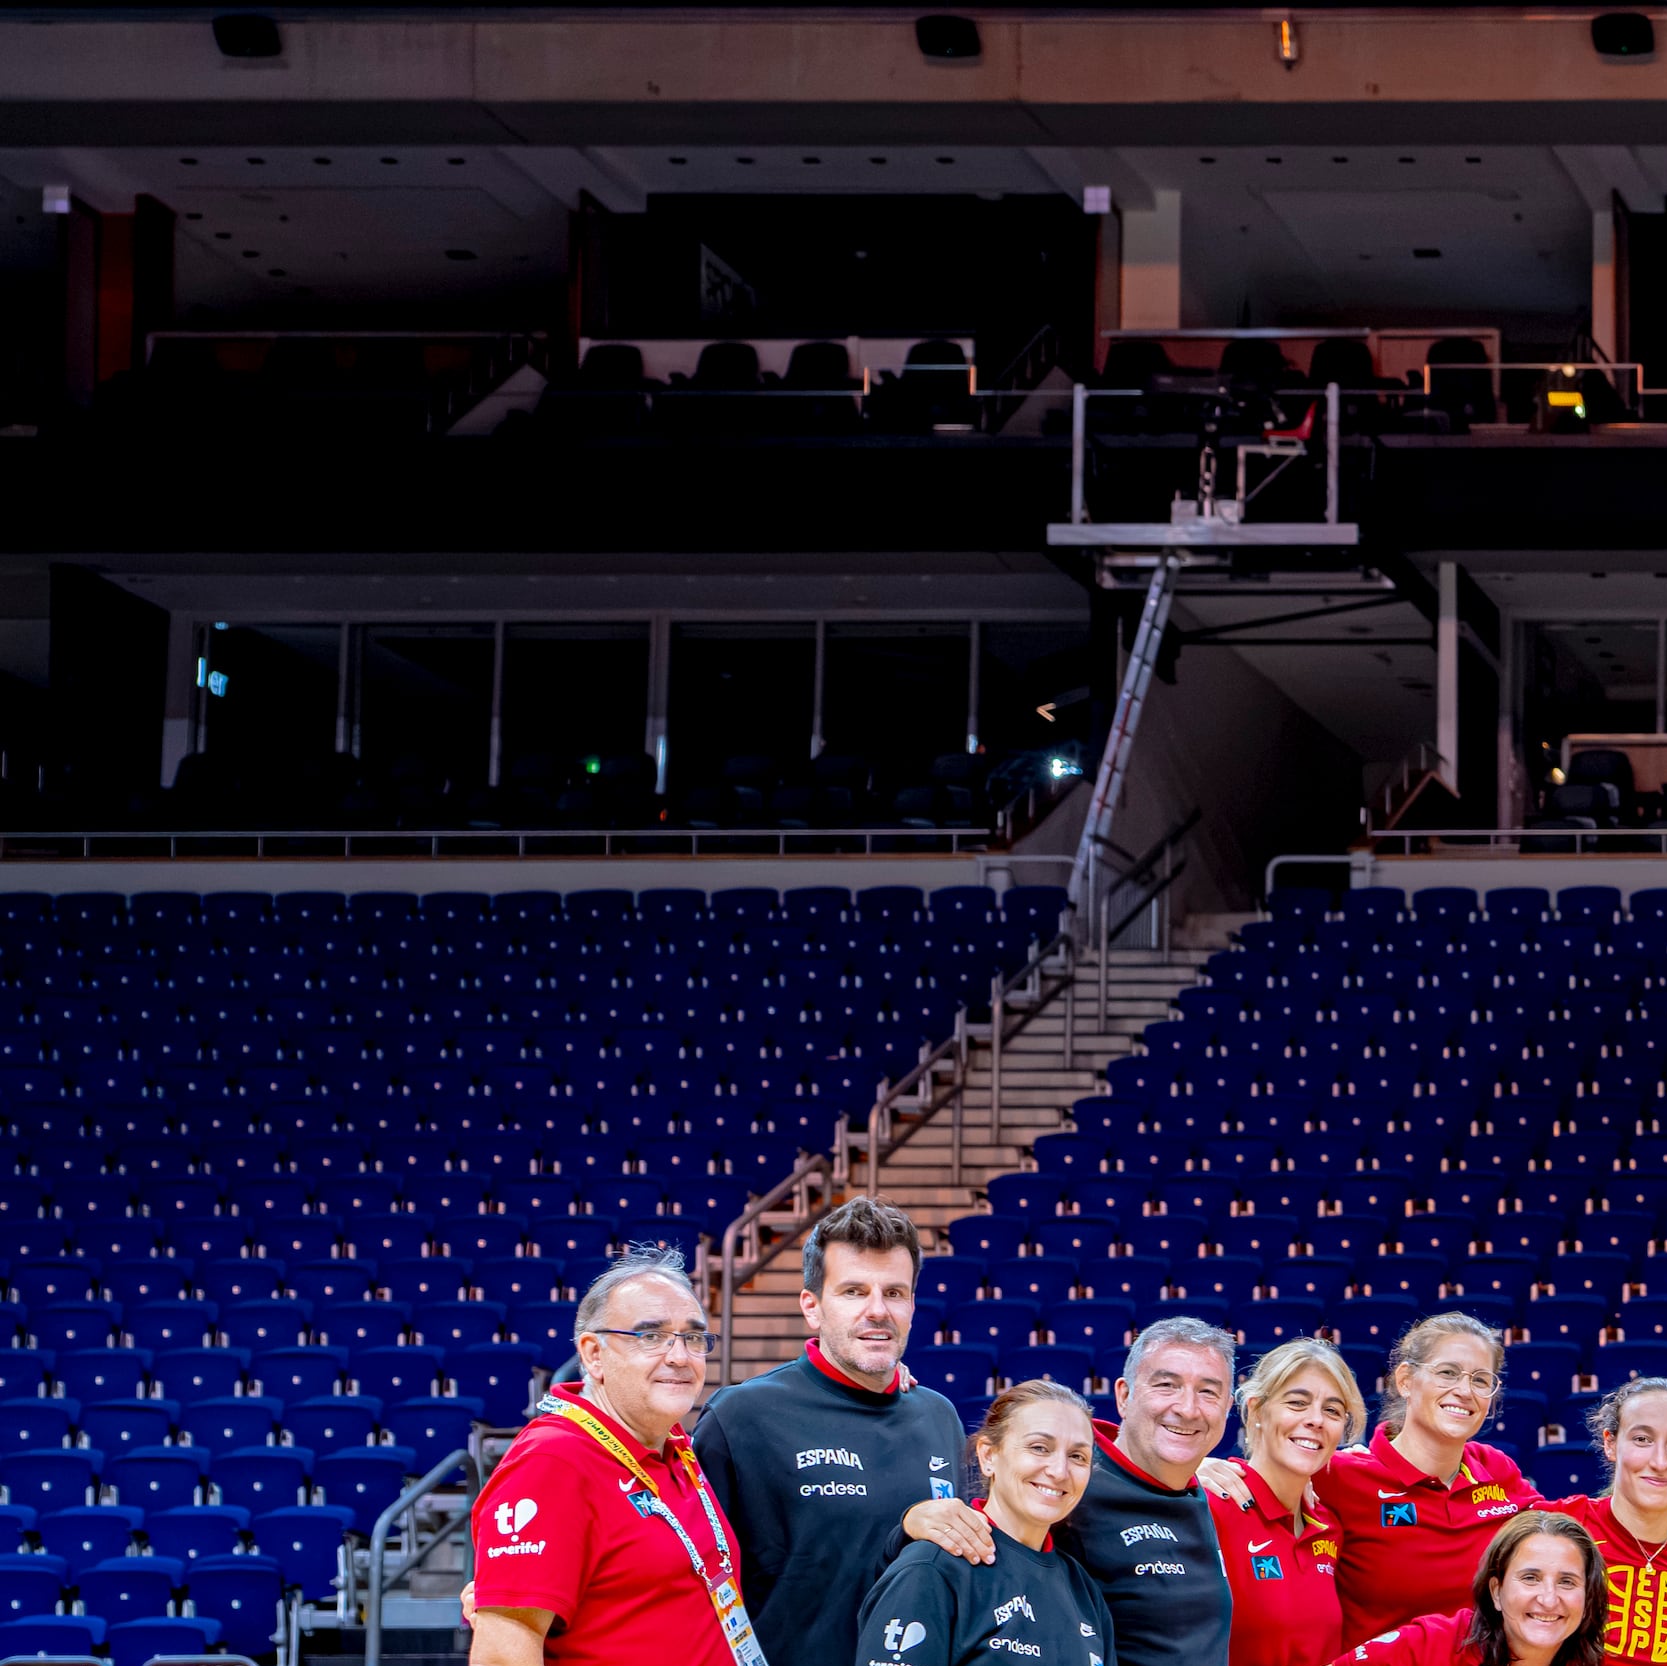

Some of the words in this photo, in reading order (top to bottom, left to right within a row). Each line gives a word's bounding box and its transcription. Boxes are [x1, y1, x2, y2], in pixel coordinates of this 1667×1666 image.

[796, 1448, 864, 1470] ESPAÑA
[800, 1481, 867, 1496] endesa
[1477, 1504, 1519, 1518] endesa
[1120, 1523, 1178, 1547] ESPAÑA
[1135, 1561, 1186, 1576] endesa
[989, 1638, 1041, 1657] endesa
